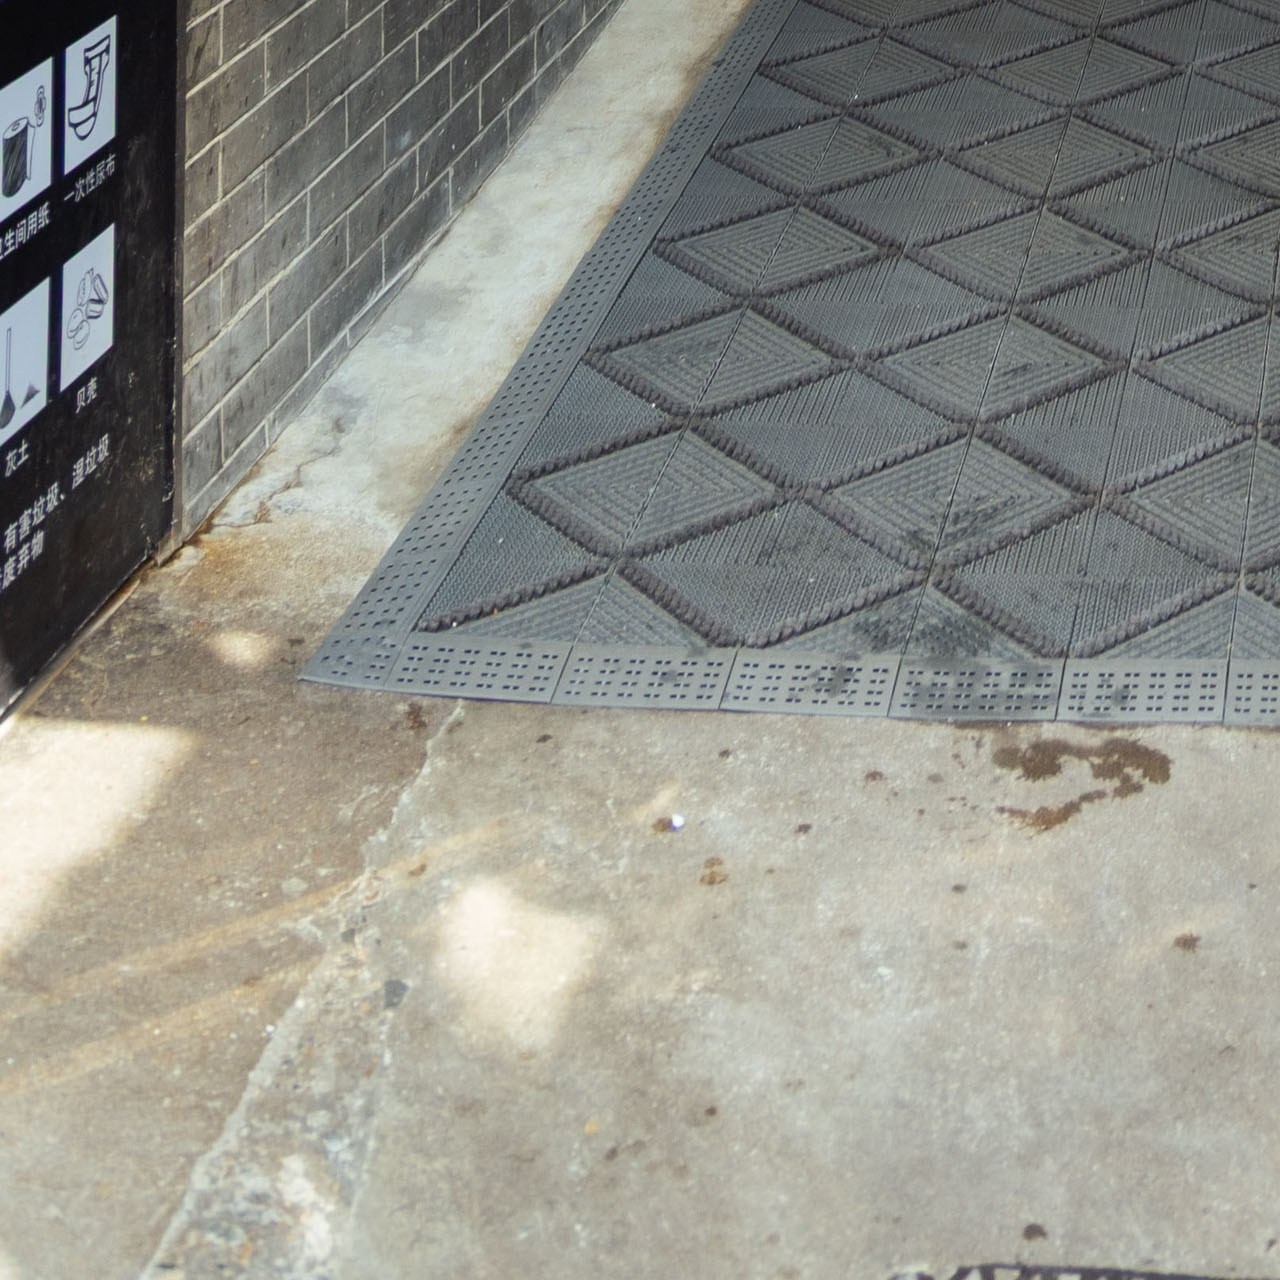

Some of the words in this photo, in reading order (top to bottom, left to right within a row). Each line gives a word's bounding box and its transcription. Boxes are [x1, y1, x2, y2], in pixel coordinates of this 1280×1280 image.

[63, 153, 116, 203] 一次性尿布
[0, 201, 50, 260] 生间用纸
[75, 376, 98, 414] 贝壳
[5, 439, 29, 478] 灰土
[0, 530, 45, 591] 废弃物
